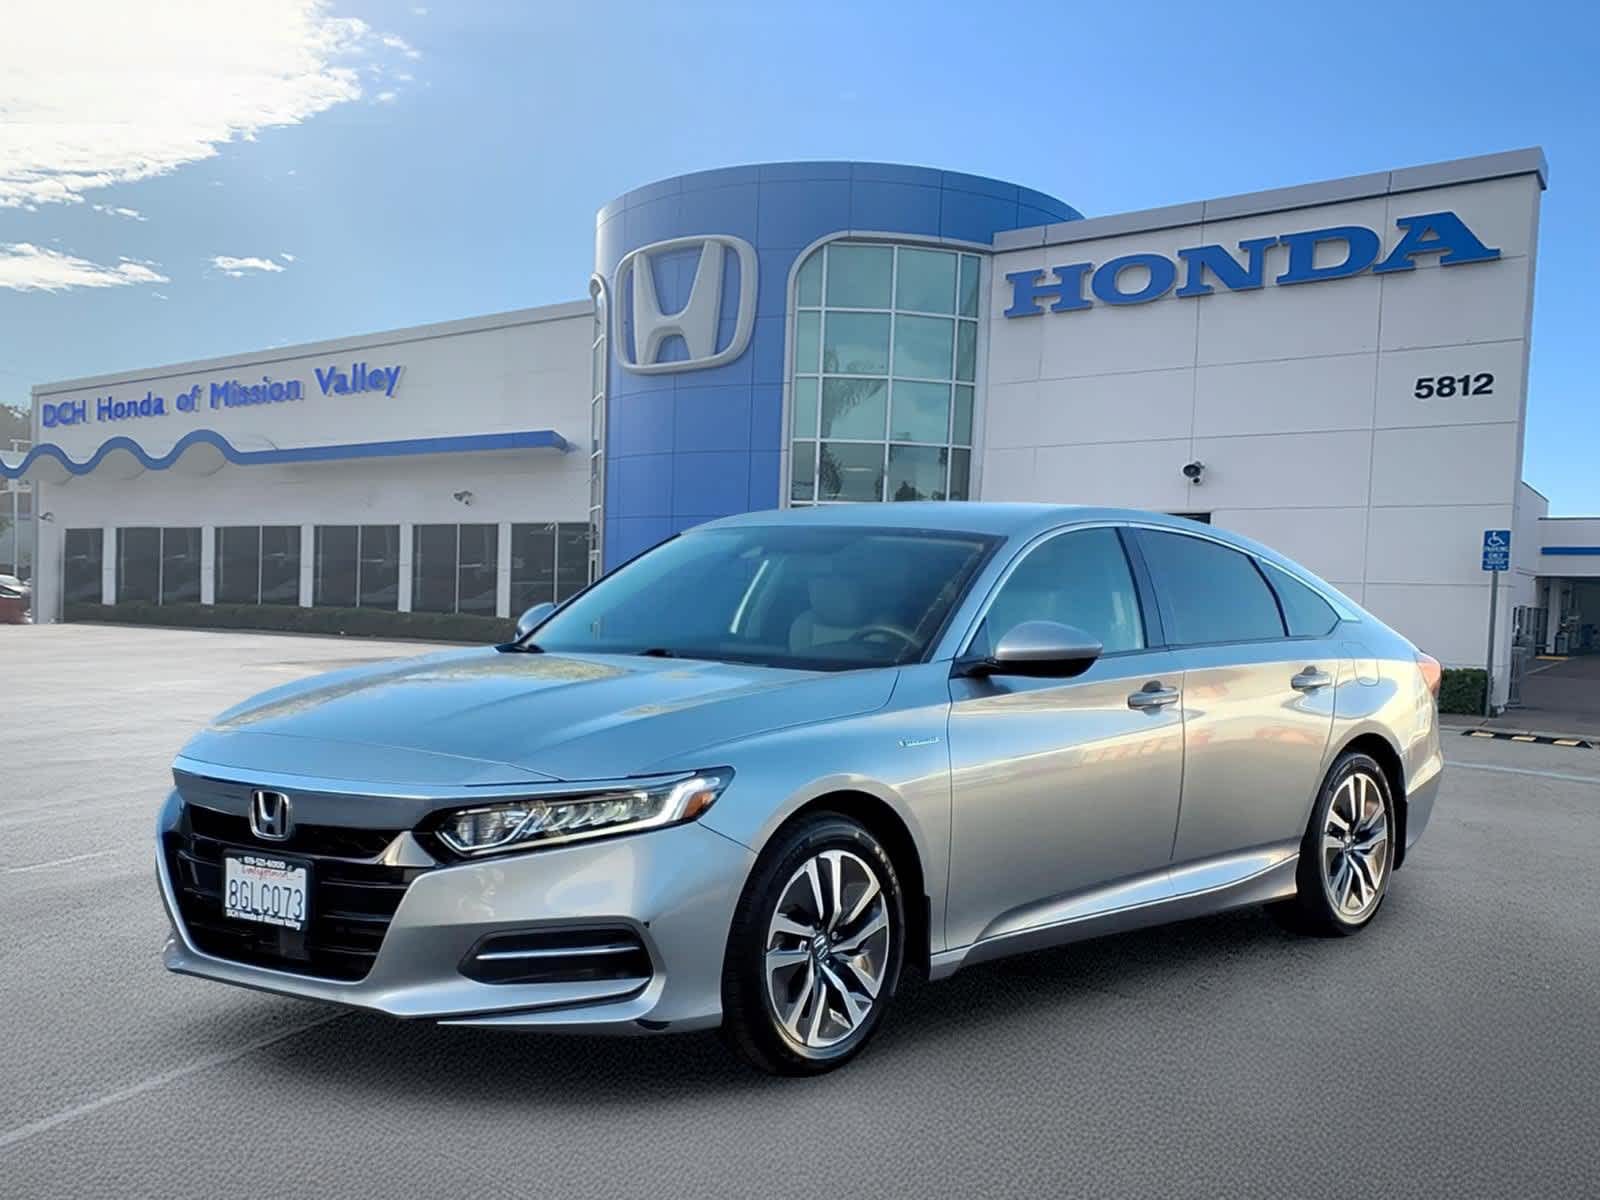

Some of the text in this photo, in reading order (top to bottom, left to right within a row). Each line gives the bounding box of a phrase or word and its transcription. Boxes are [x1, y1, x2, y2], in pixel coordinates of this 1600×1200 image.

[1004, 211, 1501, 318] HONDA
[42, 362, 402, 428] DCH Honda of Mission Valley
[1414, 373, 1494, 399] 5812
